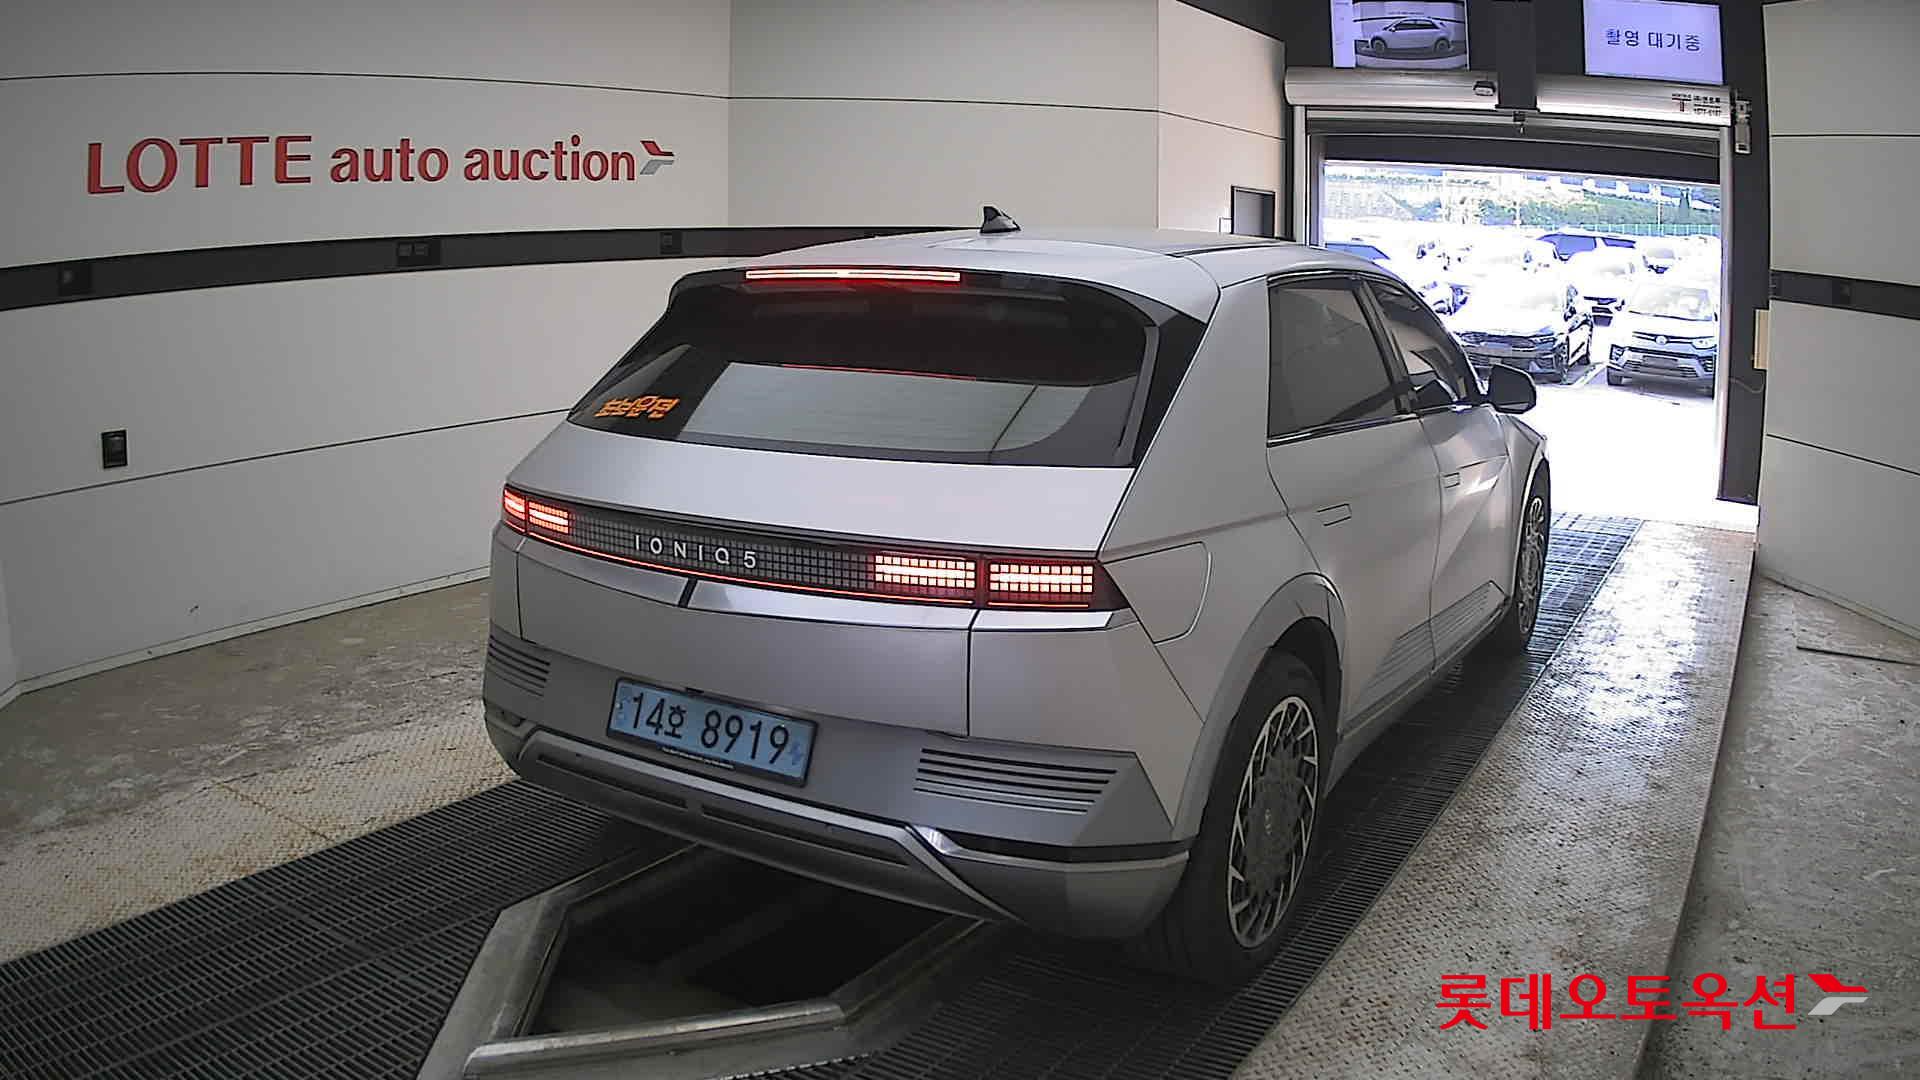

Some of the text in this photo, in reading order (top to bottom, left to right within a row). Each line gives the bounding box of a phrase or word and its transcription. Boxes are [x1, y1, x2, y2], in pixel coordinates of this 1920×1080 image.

[1607, 28, 1701, 52] 촬영 대기중
[87, 134, 636, 194] LOTTE auto auction
[634, 534, 757, 569] IONIQ 5
[632, 692, 687, 740] 14호
[701, 710, 790, 765] 8919
